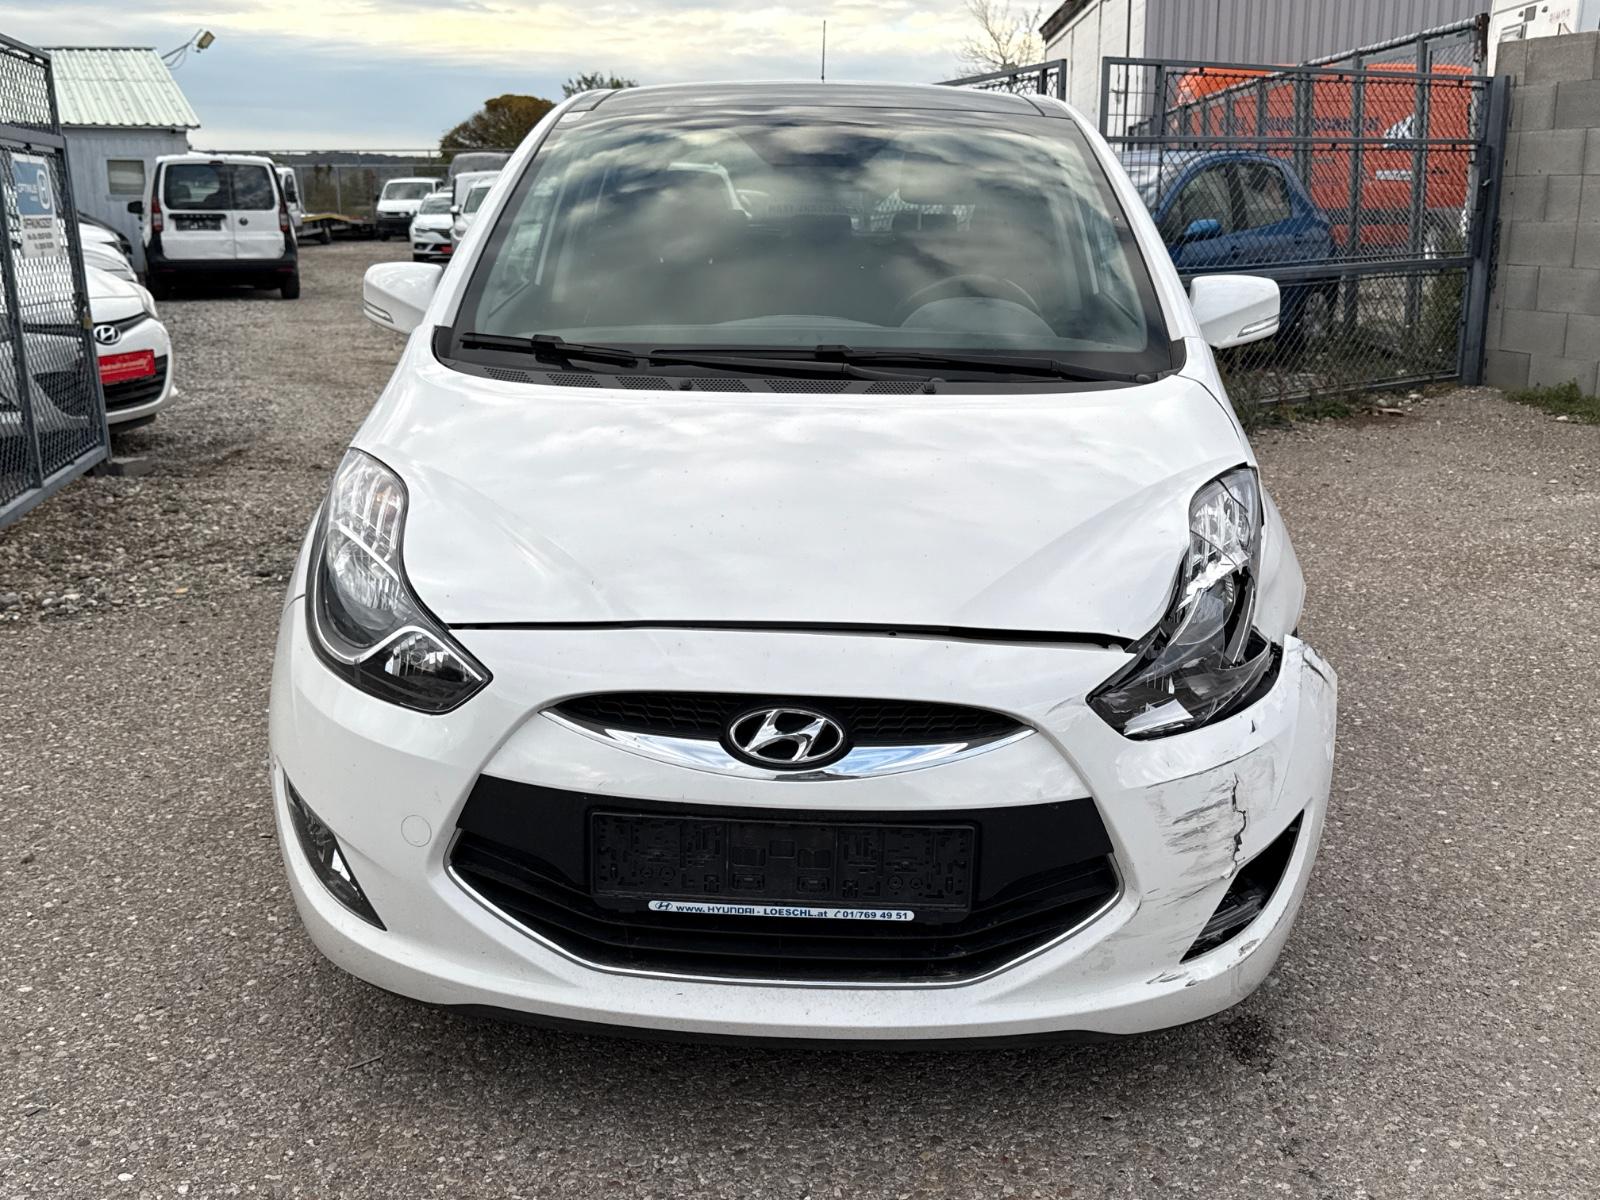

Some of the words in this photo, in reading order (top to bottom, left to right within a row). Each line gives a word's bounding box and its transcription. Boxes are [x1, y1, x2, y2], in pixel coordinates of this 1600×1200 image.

[842, 910, 877, 919] 01/769
[879, 911, 893, 920] 49
[895, 912, 908, 920] 51
